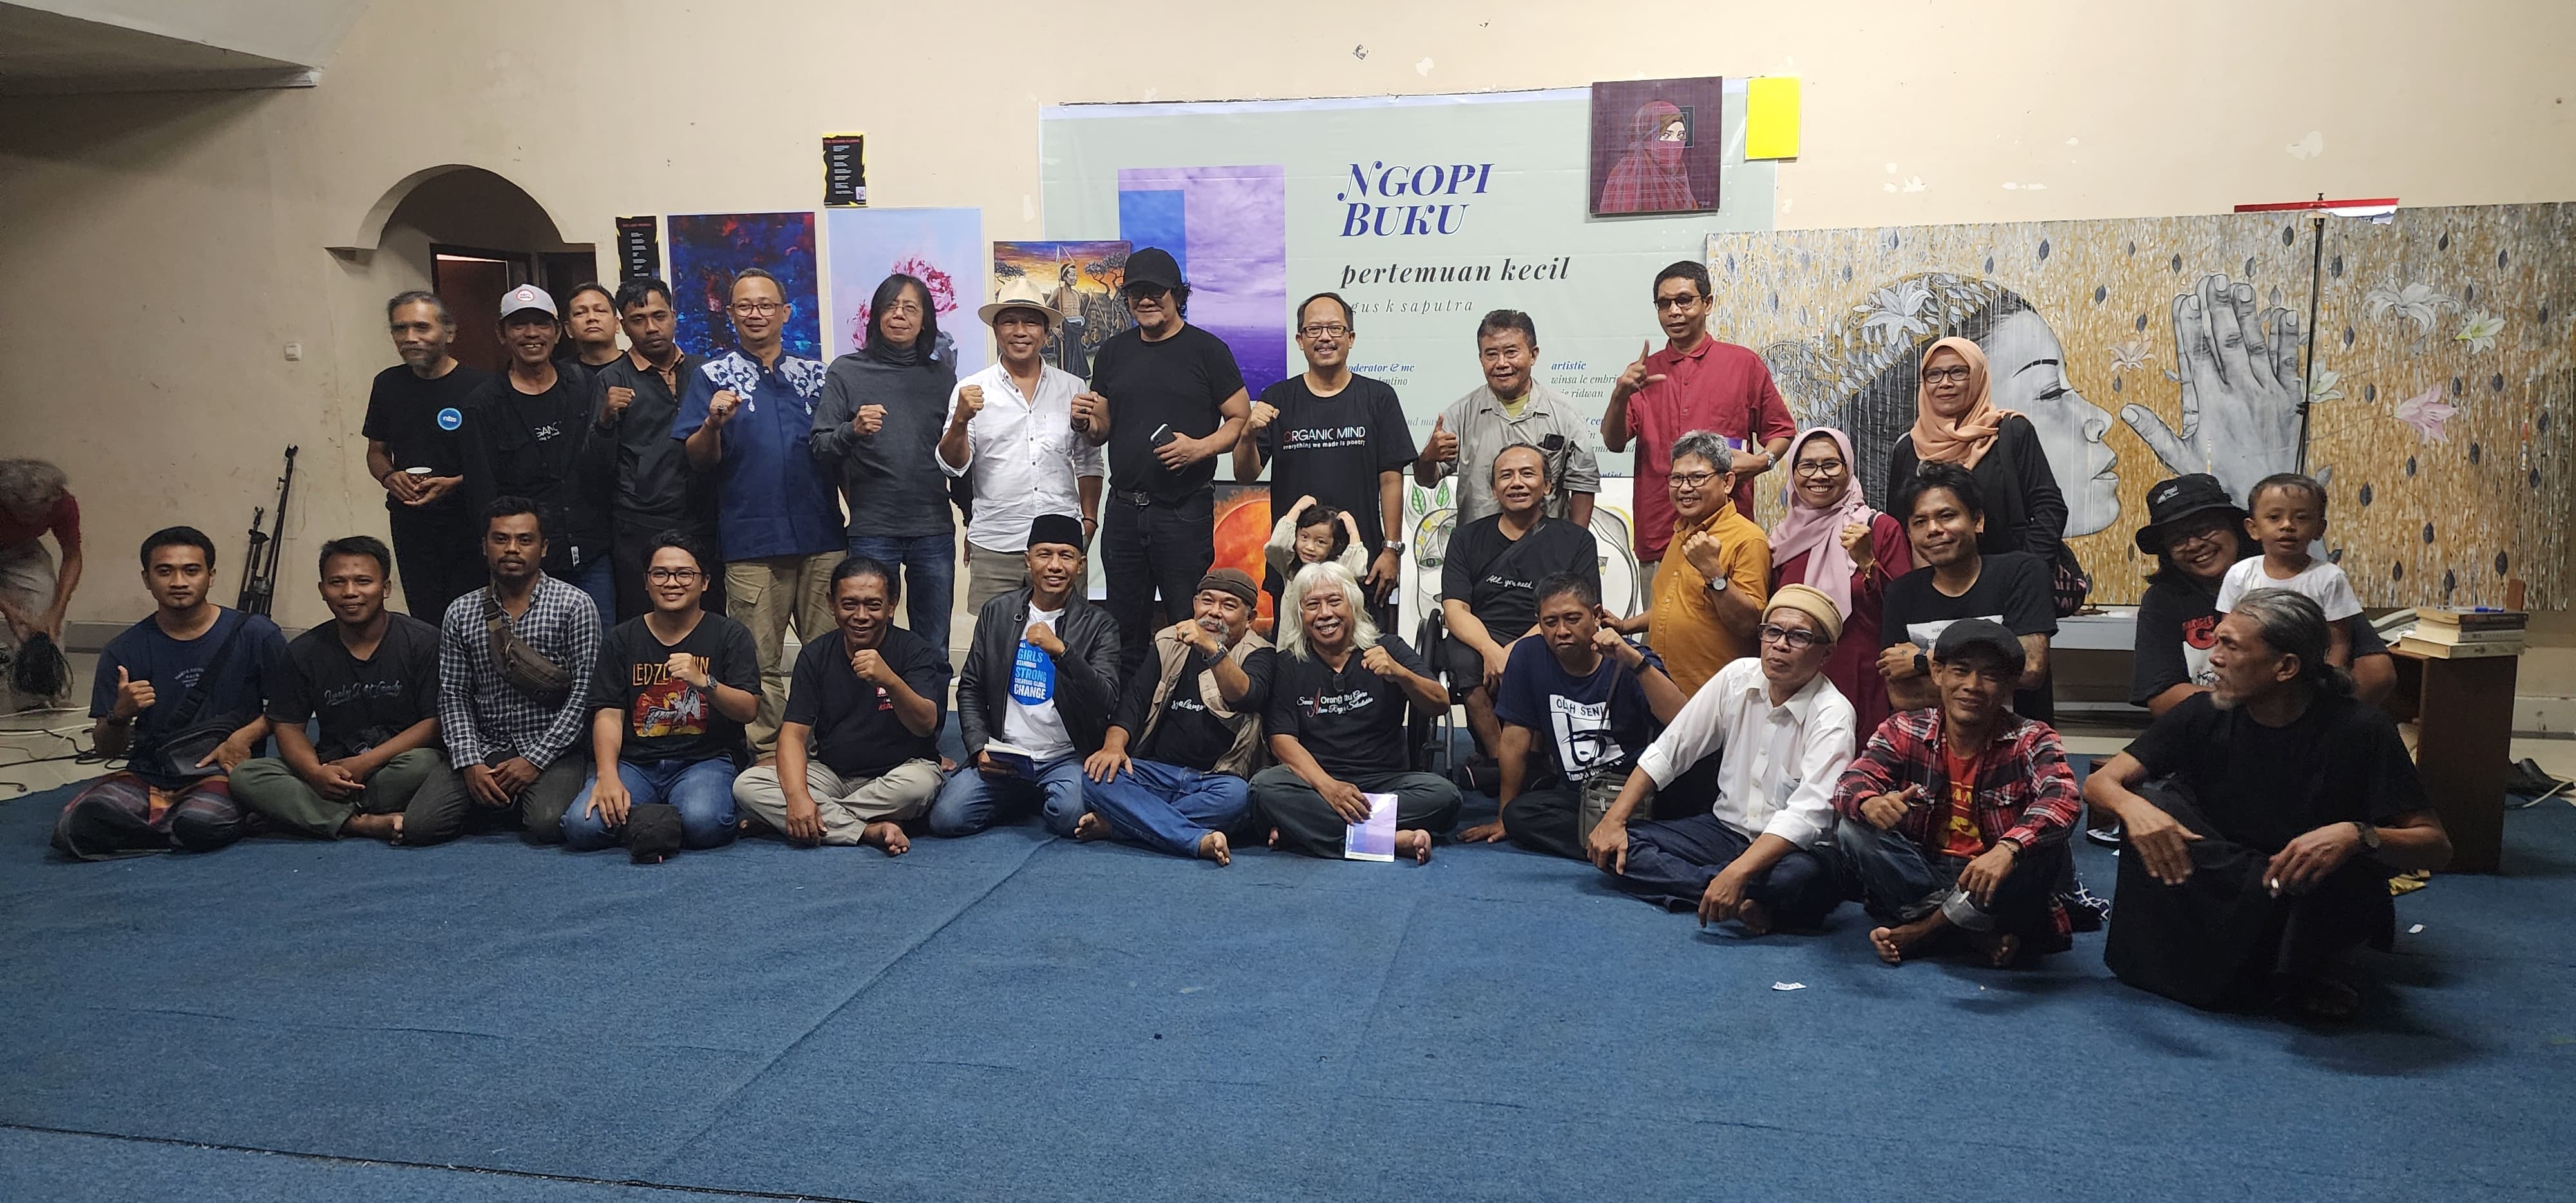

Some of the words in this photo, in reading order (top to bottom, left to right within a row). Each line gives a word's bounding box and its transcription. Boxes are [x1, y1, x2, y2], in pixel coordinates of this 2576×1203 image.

[1337, 160, 1495, 201] NGOPI
[1339, 202, 1470, 236] BUKU
[1340, 263, 1492, 289] pertemuan
[1500, 256, 1571, 281] kecil
[1351, 303, 1379, 314] gus
[1385, 299, 1394, 313] k
[1400, 299, 1473, 315] saputra
[1348, 363, 1388, 372] oderator
[1551, 361, 1587, 370] artistic
[1589, 374, 1617, 384] embri
[1571, 388, 1604, 398] ridwan
[1283, 428, 1334, 442] ORGANIC
[1337, 426, 1366, 439] MIND
[1018, 648, 1043, 663] GIRLS
[1015, 667, 1046, 683] STRONG
[1014, 683, 1046, 700] CHANGE
[1580, 705, 1604, 717] SENI
